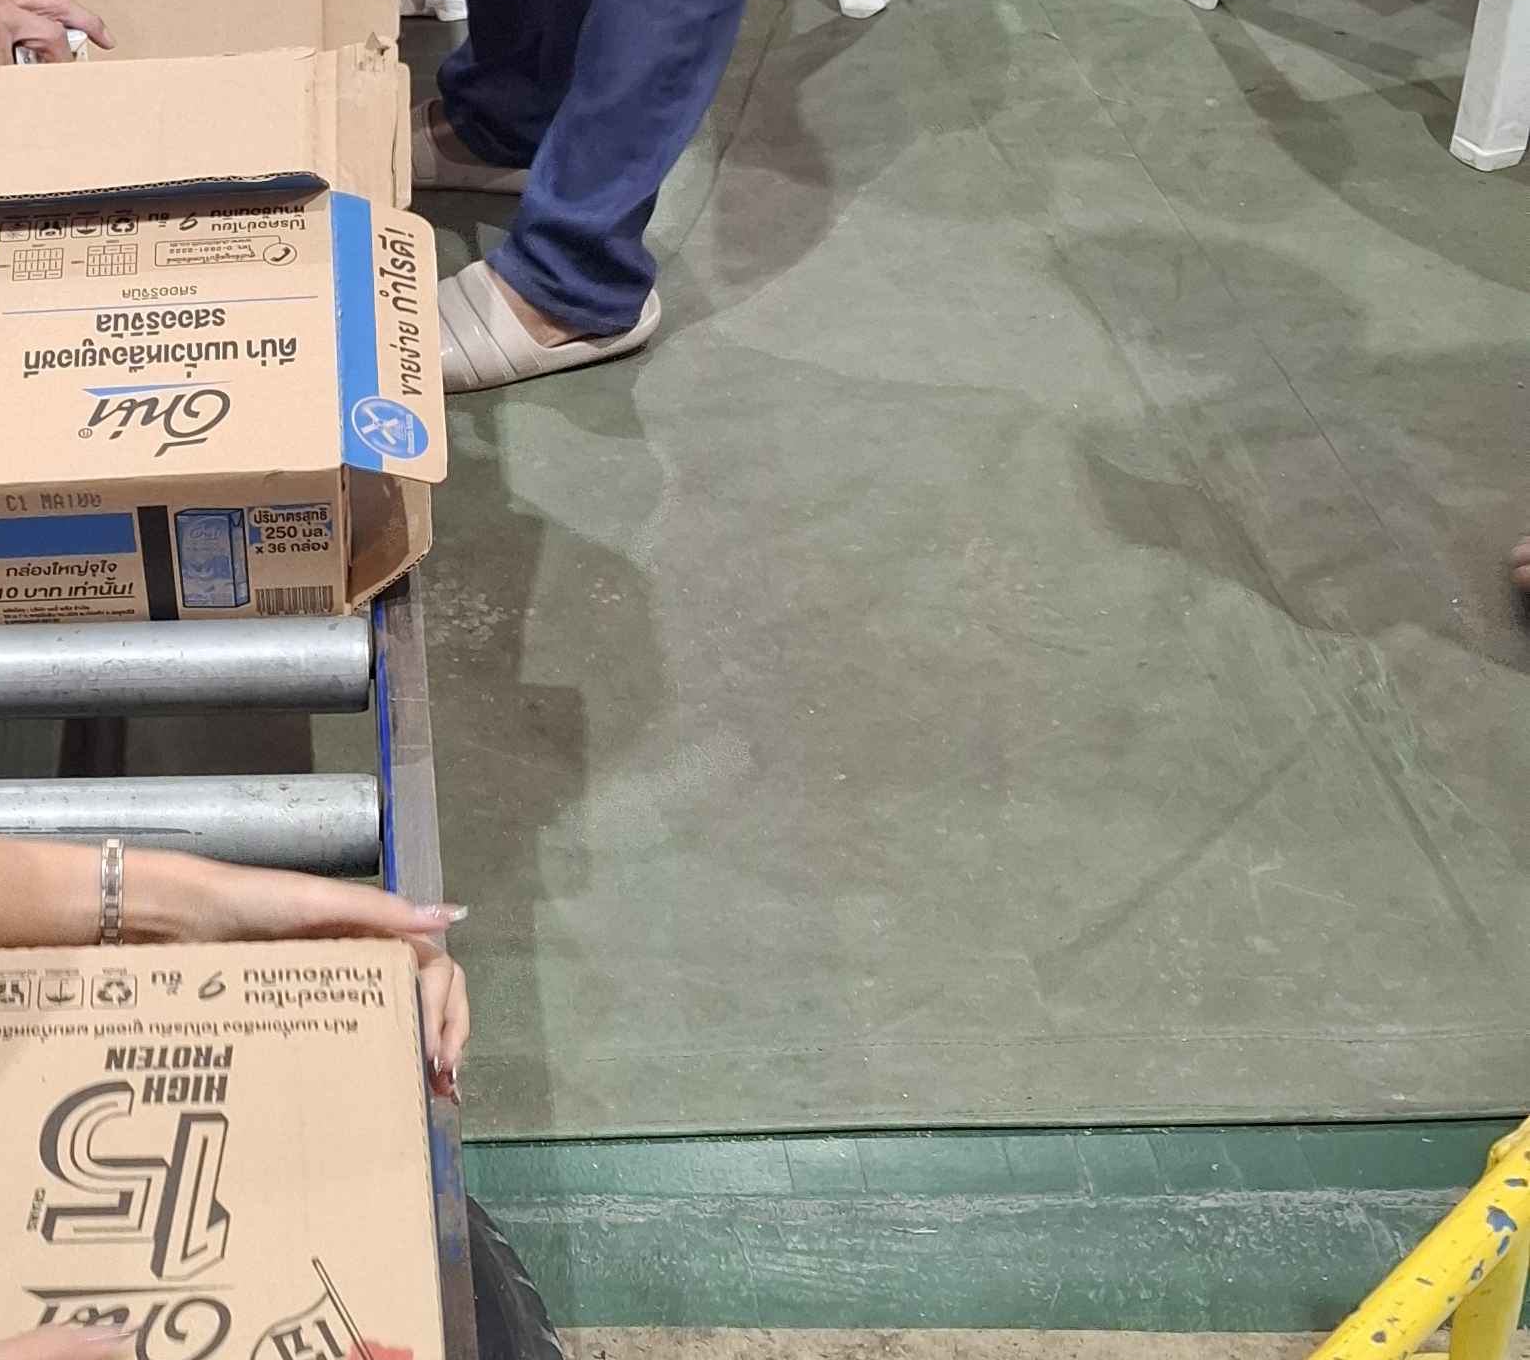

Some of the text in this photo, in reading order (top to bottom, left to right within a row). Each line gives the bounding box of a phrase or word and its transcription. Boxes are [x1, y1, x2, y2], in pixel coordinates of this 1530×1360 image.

[95, 307, 227, 339] รสออริจินัล
[23, 337, 297, 378] ดีน่า นมถั่วเหลืองยูเอชที
[253, 507, 328, 526] ปริมาตรสุทธิ
[265, 526, 298, 540] 250
[267, 542, 287, 554] 36
[290, 539, 329, 554] กล่อง
[5, 559, 117, 579] กล่องใหญ่จุใจ
[23, 586, 63, 600] บาท
[104, 1044, 234, 1072] PROTEIN
[141, 1075, 229, 1105] HIGH
[39, 1080, 232, 1281] 15
